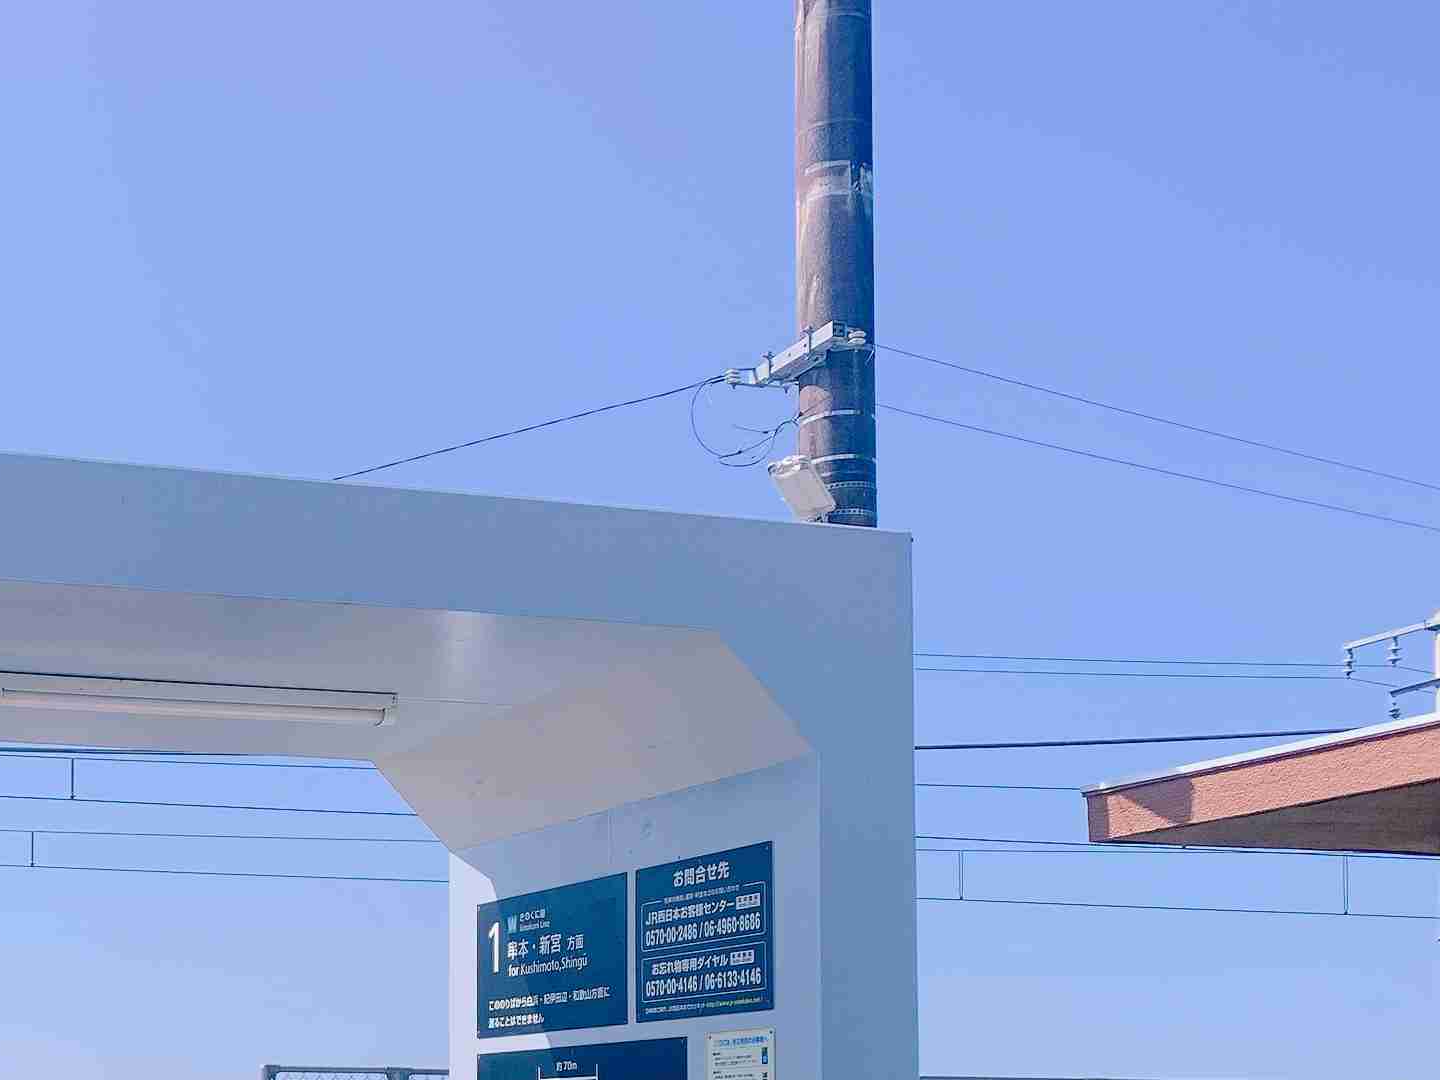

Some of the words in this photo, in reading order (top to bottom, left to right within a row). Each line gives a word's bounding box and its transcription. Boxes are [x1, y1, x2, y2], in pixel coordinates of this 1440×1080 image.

[672, 861, 730, 887] お問合せ先
[645, 899, 735, 926] JR西日本お客様センター
[488, 921, 500, 974] 1
[507, 933, 561, 960] 串本・新宮
